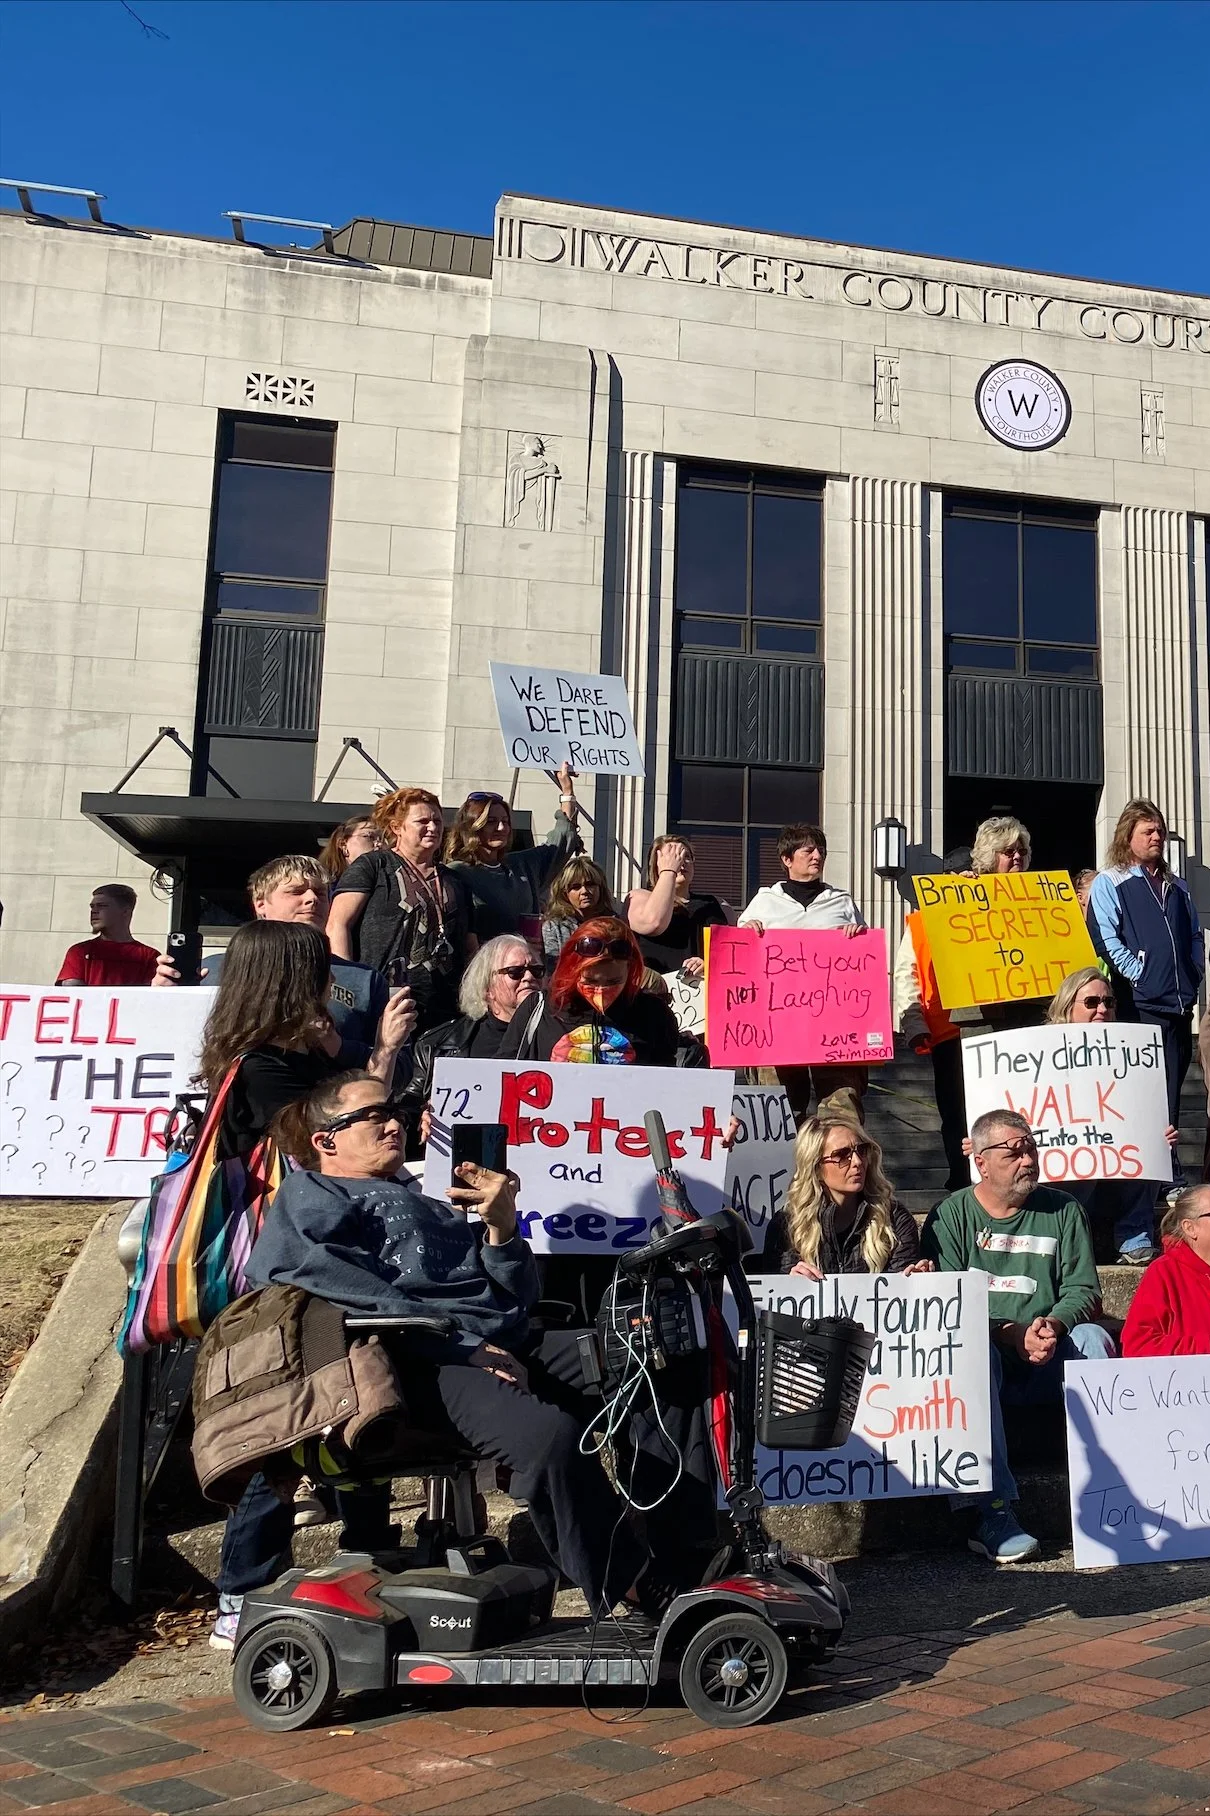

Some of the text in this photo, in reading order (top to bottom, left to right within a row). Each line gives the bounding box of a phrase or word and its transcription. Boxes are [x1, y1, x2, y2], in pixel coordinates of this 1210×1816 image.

[588, 232, 814, 299] WALKER
[841, 271, 1055, 329] COUNTY
[987, 368, 1059, 403] WALKER COUNTY
[1007, 389, 1039, 419] W
[991, 415, 1054, 440] COURTHOUSE
[556, 676, 608, 706] DARE
[525, 705, 627, 739] DEFEND
[512, 737, 630, 767] OUR RIGHTS
[917, 874, 1074, 911] Bring ALL the
[949, 906, 1071, 944] SECRETS
[720, 940, 876, 982] I Bet your
[994, 941, 1024, 967] to
[768, 980, 872, 1018] Laughing
[968, 960, 1071, 1004] LIGHT
[0, 994, 137, 1045] TELL
[723, 1015, 774, 1052] NOW
[824, 1046, 893, 1063] Stimpson
[965, 1029, 1163, 1084] They didn't just
[34, 1052, 175, 1101] THE
[499, 1069, 725, 1161] Protect
[732, 1093, 798, 1145] STICE
[1004, 1080, 1125, 1127] WALK
[1082, 1125, 1114, 1146] the
[549, 1162, 604, 1184] and
[1040, 1144, 1143, 1182] OODS
[730, 1168, 789, 1228] ACE
[515, 1210, 664, 1249] reez
[866, 1276, 962, 1335] found
[888, 1332, 963, 1379] that
[863, 1379, 968, 1439] Smith
[1080, 1373, 1137, 1416] We
[758, 1435, 980, 1501] doesn't like
[1083, 1485, 1167, 1542] Tony
[429, 1615, 472, 1630] Scout
